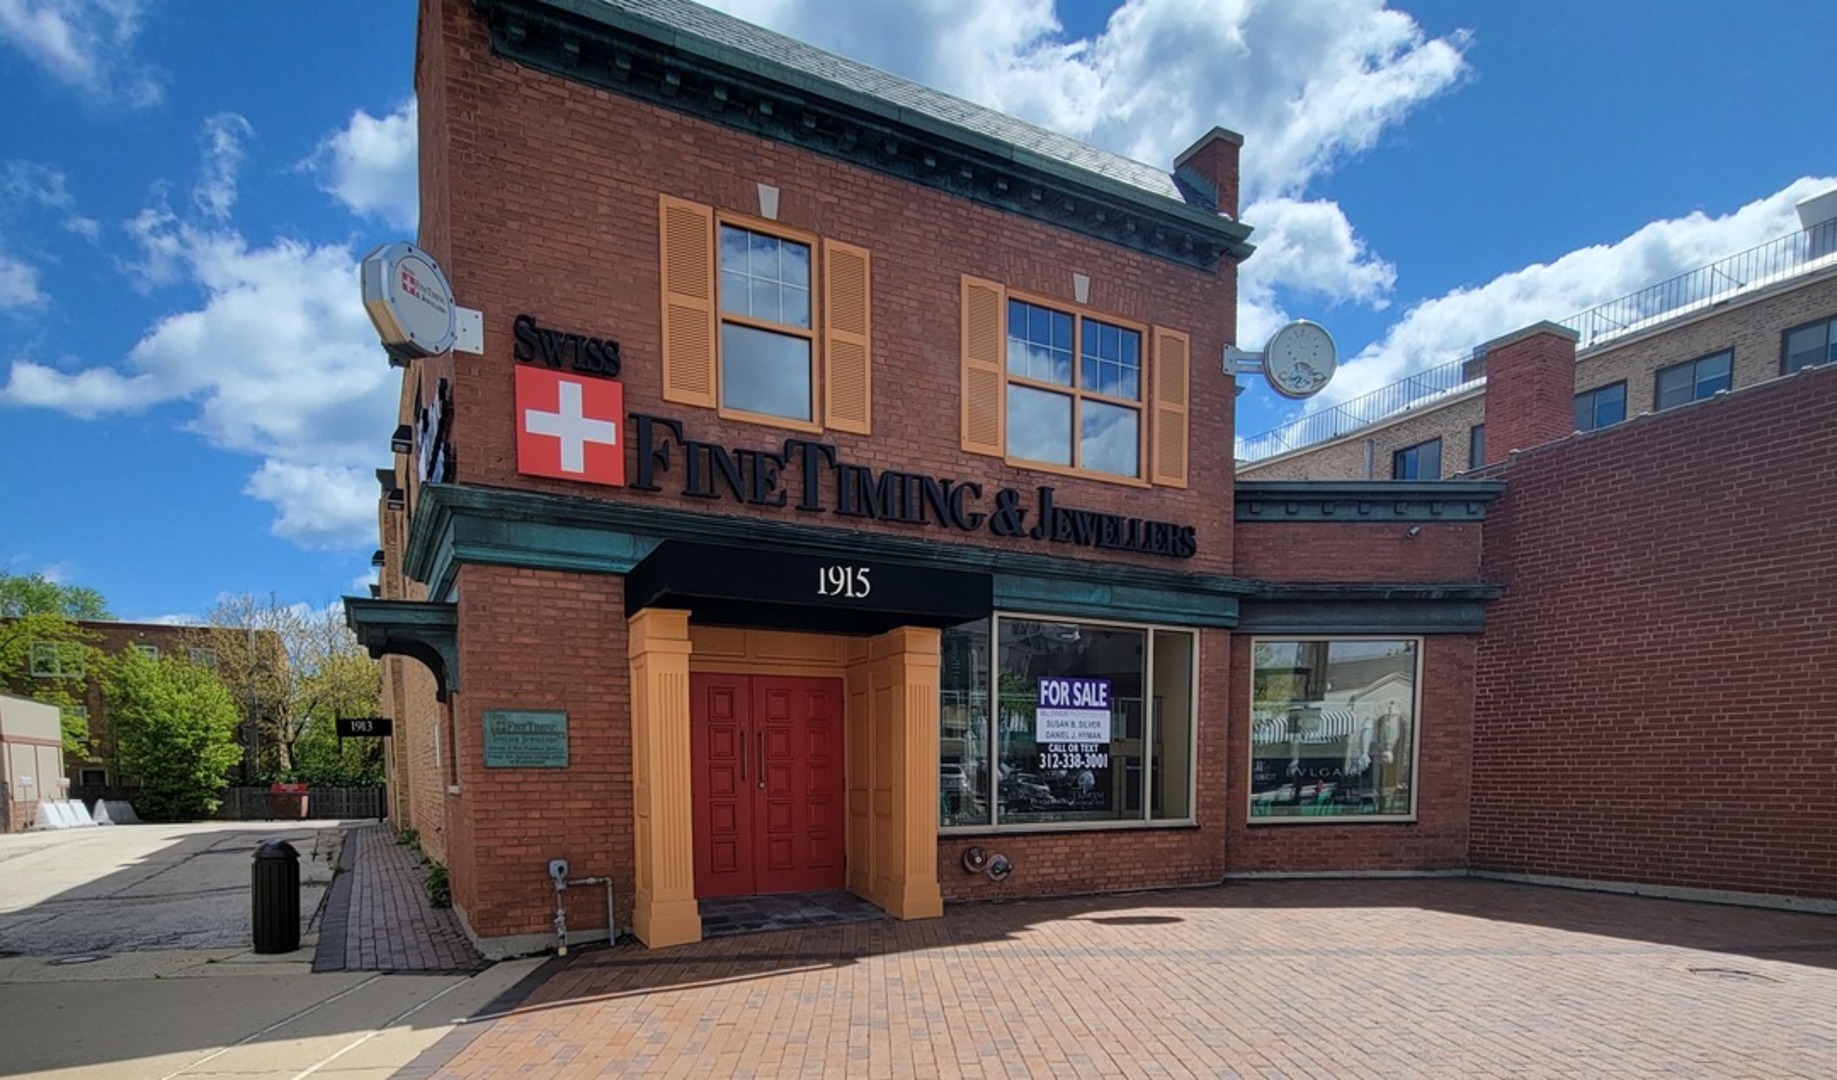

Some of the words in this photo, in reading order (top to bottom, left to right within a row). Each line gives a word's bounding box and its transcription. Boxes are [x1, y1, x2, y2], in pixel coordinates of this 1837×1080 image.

[513, 314, 621, 377] SWISS
[989, 487, 1029, 538] &
[1031, 486, 1197, 558] JEWELLERS
[817, 566, 870, 598] 1915
[1041, 680, 1070, 706] FOR
[1073, 681, 1107, 707] SALE
[351, 720, 373, 732] 1913
[1046, 720, 1069, 728] SUSAN
[1079, 720, 1101, 728] SILVER
[1046, 731, 1069, 739] DANIEL
[1078, 731, 1102, 739] HYMAN
[1048, 743, 1067, 752] CALL
[1068, 743, 1079, 752] OR
[1081, 744, 1099, 753] TEXT
[1039, 753, 1108, 769] 312-338-3001
